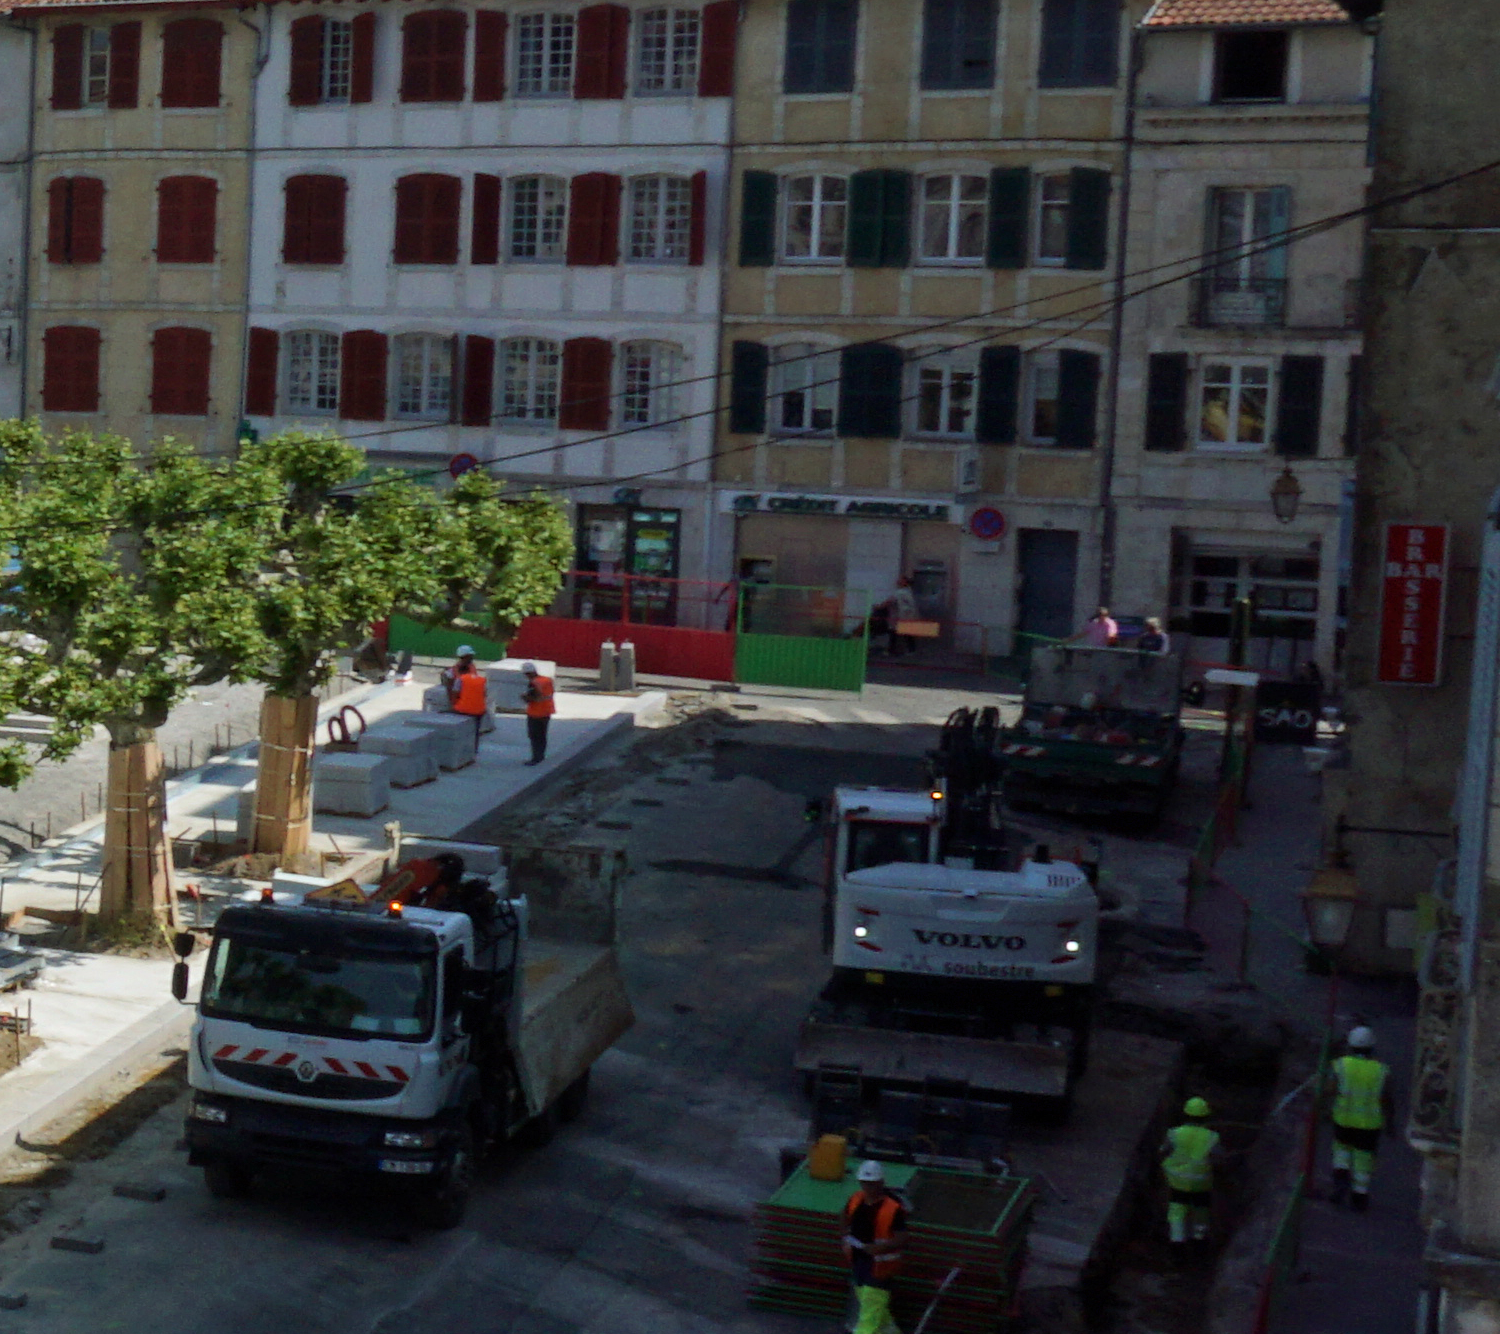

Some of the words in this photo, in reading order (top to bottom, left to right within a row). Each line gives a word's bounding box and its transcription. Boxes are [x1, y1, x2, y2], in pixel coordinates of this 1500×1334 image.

[1387, 562, 1440, 577] BAR
[1399, 529, 1425, 679] BRASSERIE
[912, 929, 1026, 950] VOLVO
